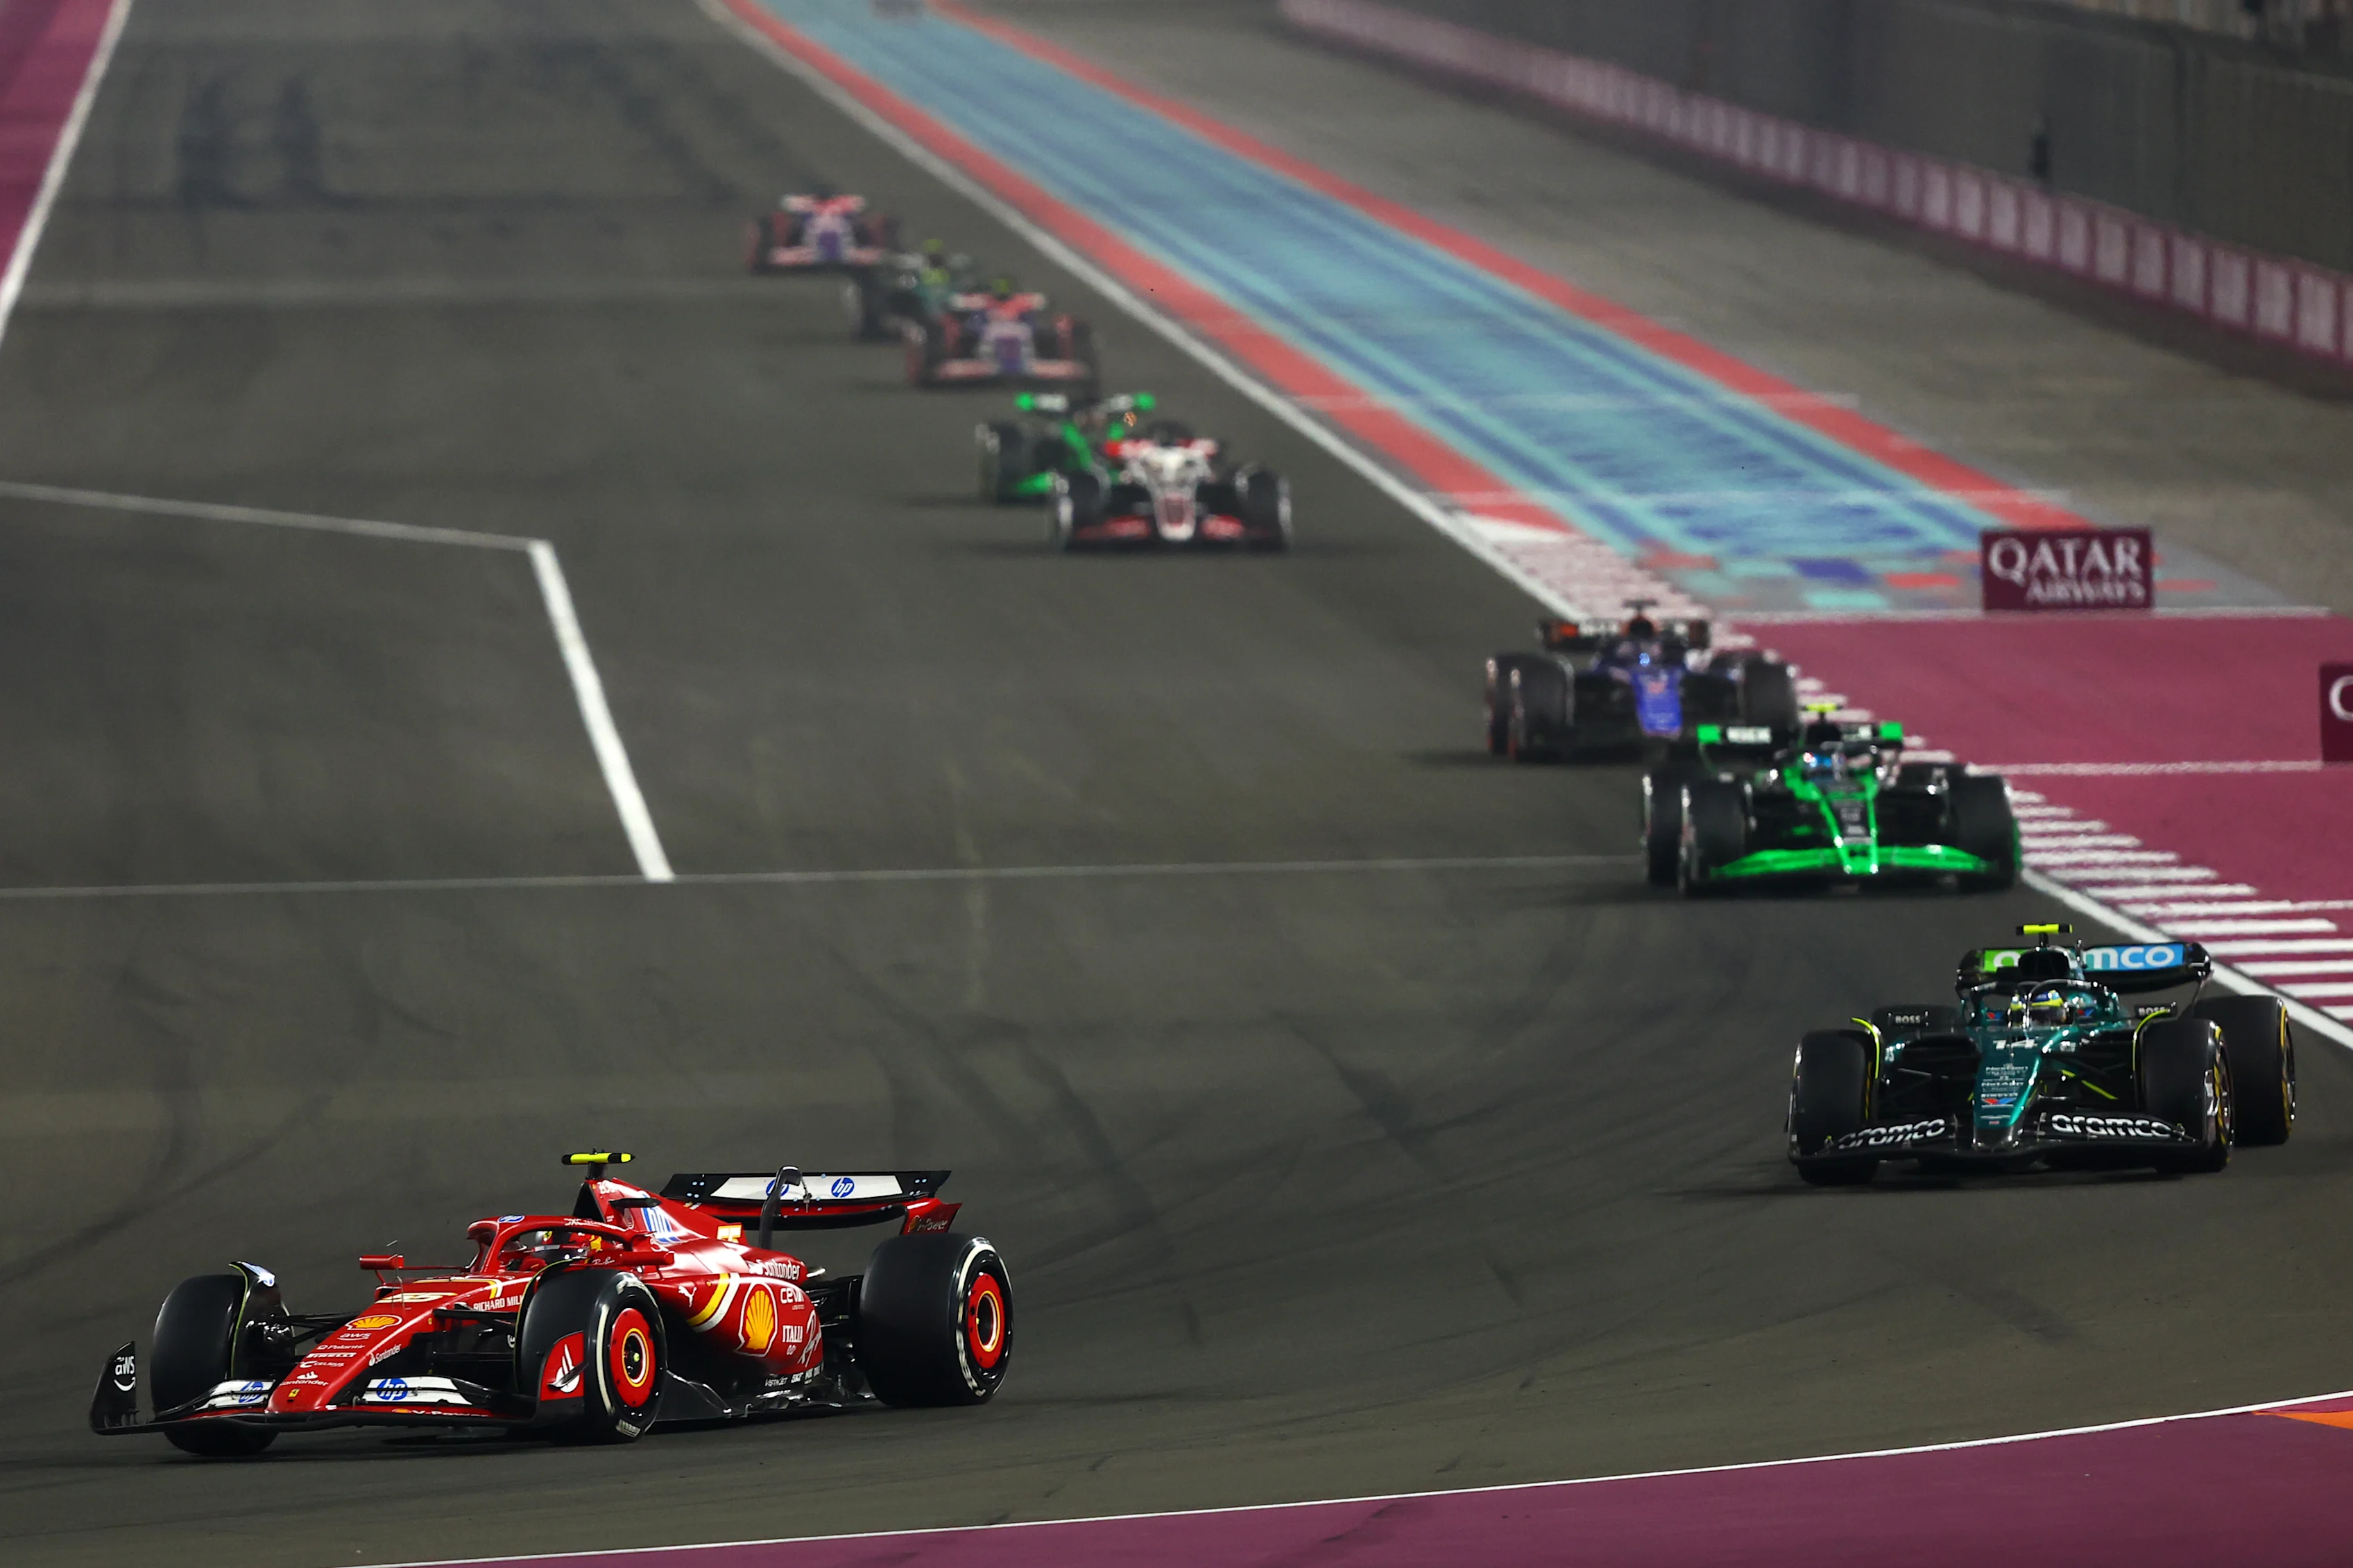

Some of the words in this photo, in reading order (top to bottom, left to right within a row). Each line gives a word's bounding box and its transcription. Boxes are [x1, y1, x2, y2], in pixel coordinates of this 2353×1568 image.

[1989, 537, 2142, 587] QATAR
[1993, 946, 2175, 970] amco
[1895, 1015, 1921, 1024] BOSS
[1838, 1119, 1945, 1149] aramco
[2052, 1114, 2172, 1138] aramco
[833, 1178, 854, 1198] hp
[764, 1259, 800, 1280] Santander
[473, 1298, 505, 1311] RICHARD
[506, 1295, 522, 1307] MILL
[375, 1343, 402, 1364] Santander
[115, 1356, 135, 1375] aws
[240, 1381, 263, 1403] hp
[379, 1378, 407, 1401] hp
